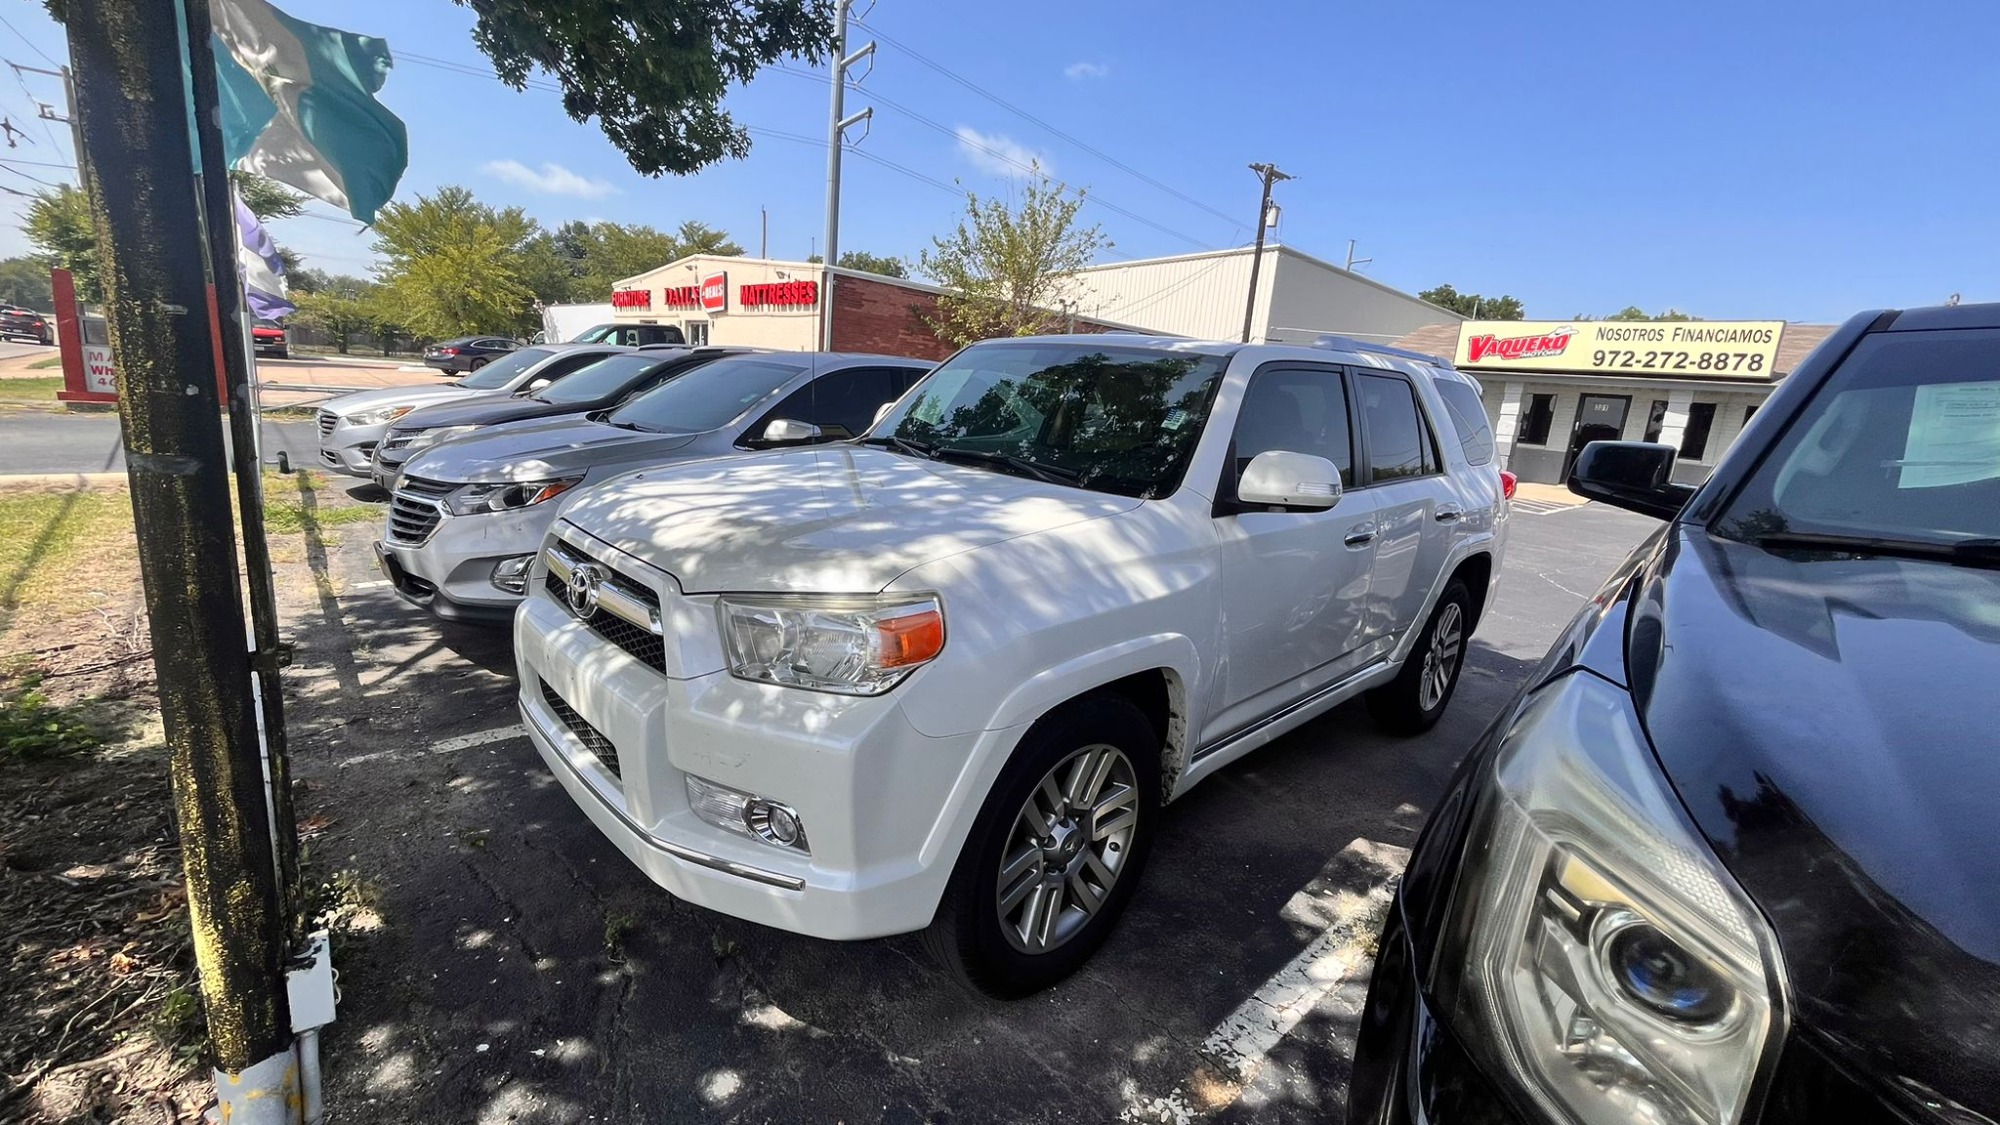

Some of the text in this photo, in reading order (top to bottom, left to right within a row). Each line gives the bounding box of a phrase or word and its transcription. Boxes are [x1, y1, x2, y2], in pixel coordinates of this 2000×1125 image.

[612, 290, 651, 306] FURNITURE
[664, 286, 700, 305] DAILY
[740, 281, 818, 305] MATTRESSES
[1596, 327, 1773, 344] NOSOTROS FINANCIAMOS
[1469, 333, 1571, 361] VAQUERO
[1592, 350, 1764, 372] 972-272-8878
